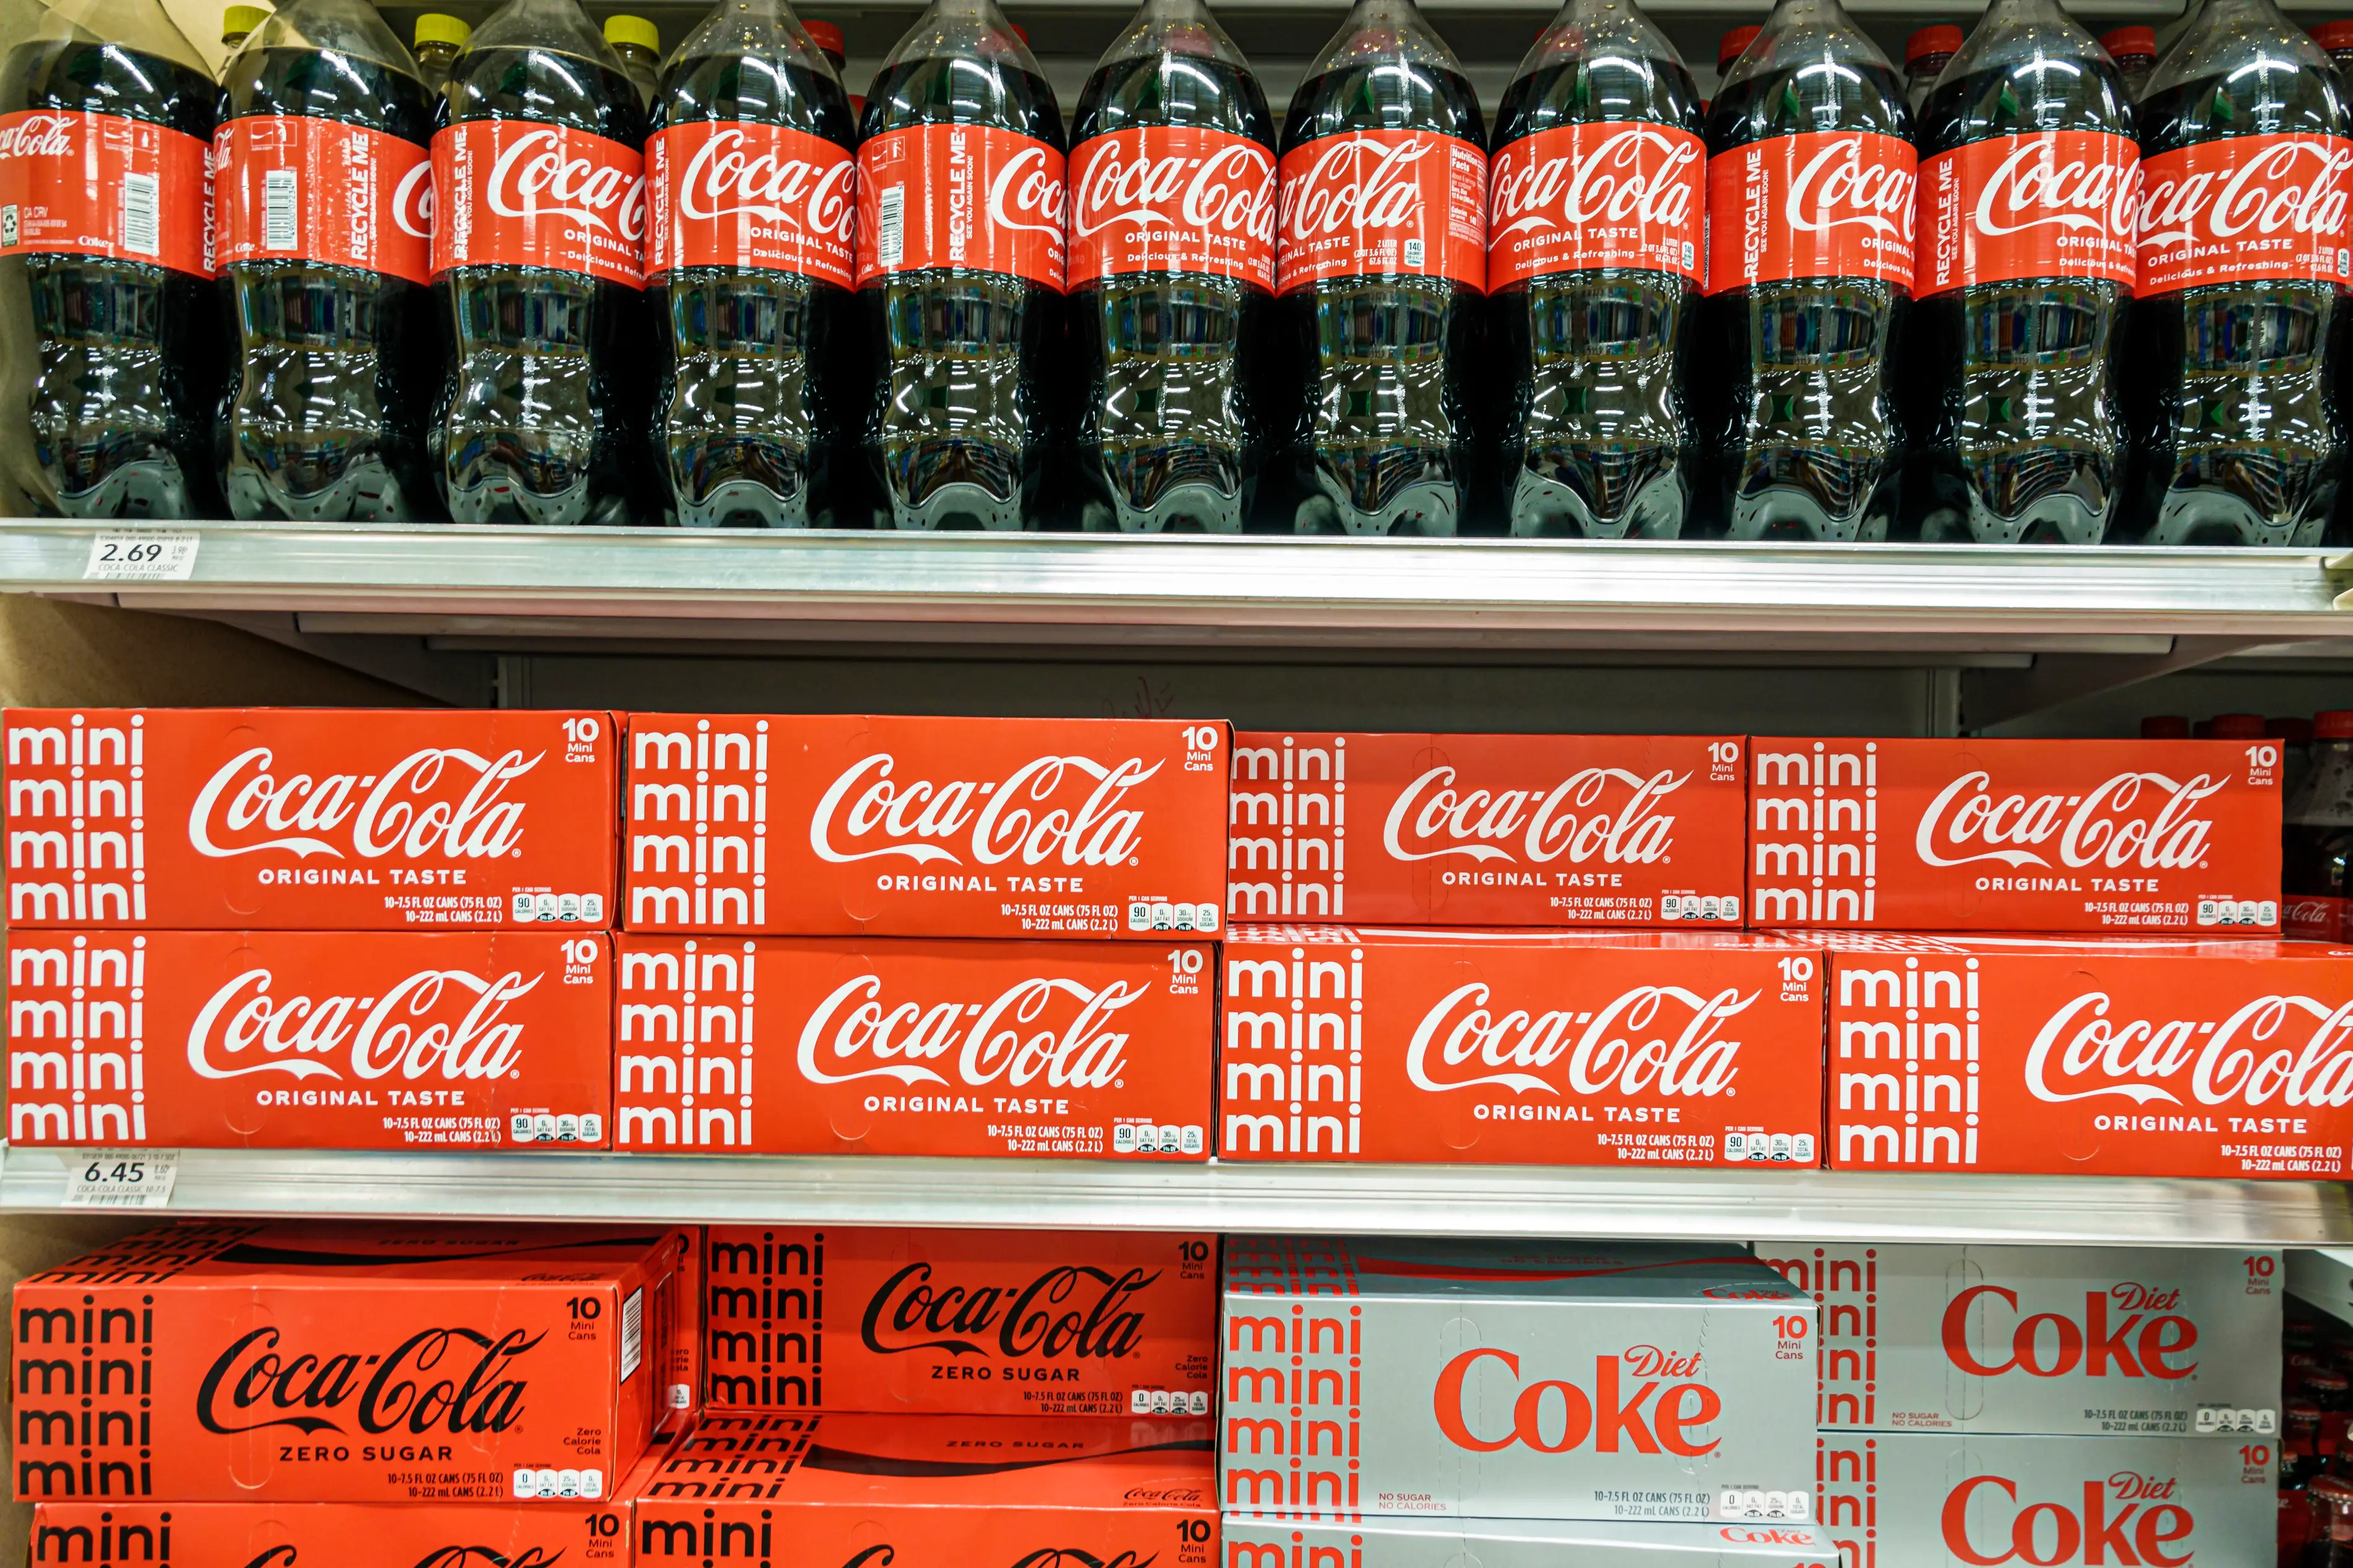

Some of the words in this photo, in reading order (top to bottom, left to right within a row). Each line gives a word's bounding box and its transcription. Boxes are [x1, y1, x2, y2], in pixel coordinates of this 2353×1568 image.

[0, 116, 78, 158] a-Cola
[352, 131, 369, 165] ME
[950, 131, 965, 166] ME
[204, 147, 215, 181] ME
[656, 137, 665, 169] ME
[1452, 147, 1477, 166] Nutrition
[1452, 158, 1470, 172] Facts
[1747, 149, 1761, 182] ME
[1939, 157, 1952, 191] ME
[487, 129, 645, 241] Coca-C
[681, 129, 856, 244] Coca-Co
[1076, 140, 1277, 246] Coca-Cola
[1278, 139, 1435, 241] a-Cola
[1488, 130, 1699, 251] Coca-Cola
[1786, 139, 1917, 243] Coca-
[1975, 139, 2140, 236] Coca-C
[2138, 141, 2353, 248] ca-Cola
[351, 168, 368, 261] RECYCLE
[655, 171, 664, 265] RECYCLE
[950, 168, 965, 261] RECYCLE
[203, 183, 215, 272] RECYCLE
[1744, 185, 1760, 278] RECYCLE
[1936, 193, 1952, 286] RECYCLE
[78, 236, 109, 247] Coke
[564, 228, 632, 257] ORIGINAL
[750, 227, 822, 249] ORIGINAL
[825, 241, 853, 264] TASTE
[1125, 231, 1200, 243] ORIGINAL
[1207, 233, 1246, 251] TASTE
[1308, 236, 1350, 251] TASTE
[1382, 240, 1397, 248] LITER
[1409, 243, 1421, 251] 140
[1514, 229, 1582, 253] ORIGINAL
[1588, 228, 1638, 239] TASTE
[1861, 237, 1910, 256] ORIGINAL
[2057, 236, 2122, 252] ORIGINAL
[568, 251, 615, 269] Delicious
[753, 248, 802, 262] Delicious
[806, 257, 812, 266] &
[815, 259, 852, 282] Refreshing
[1128, 254, 1179, 262] Delicious
[1181, 253, 1188, 261] &
[1191, 254, 1243, 270] Refreshing
[1516, 254, 1559, 271] Delicious
[1563, 253, 1569, 261] &
[1574, 249, 1635, 260] Refreshing
[2059, 258, 2107, 268] Delicious
[2147, 243, 2231, 267] ORIGINAL
[2237, 239, 2292, 252] TASTE
[1300, 259, 1347, 275] Refreshing
[1864, 259, 1900, 272] Delicious
[2150, 270, 2202, 285] Delicious
[2207, 266, 2214, 274] &
[2220, 261, 2289, 273] Refreshing
[100, 544, 162, 561] 2.69
[9, 714, 144, 765] mini
[563, 718, 599, 742] 10
[1183, 727, 1217, 750] 10
[635, 719, 768, 770] mini
[1186, 752, 1211, 761] Mini
[2246, 747, 2276, 766] 10
[1184, 762, 1213, 771] Cans
[189, 748, 546, 859] Coca-Cola
[635, 771, 767, 821] mini
[811, 753, 1166, 866] Coca-Cola
[1384, 766, 1694, 863] Coca-Cola
[1916, 771, 2230, 868] Coca-Cola
[633, 823, 766, 872] mini
[259, 869, 380, 884] ORIGINAL
[390, 870, 466, 884] TASTE
[877, 875, 996, 891] ORIGINAL
[1007, 877, 1082, 892] TASTE
[1442, 872, 1546, 885] ORIGINAL
[1556, 873, 1622, 886] TASTE
[1976, 878, 2081, 891] ORIGINAL
[2092, 879, 2158, 891] TASTE
[632, 875, 766, 924] mini
[1001, 904, 1027, 916] 10-7.5
[1029, 904, 1038, 916] FL
[1040, 904, 1050, 916] OZ
[1053, 904, 1074, 916] CANS
[1076, 904, 1090, 917] (75
[1092, 904, 1101, 916] FL
[1103, 904, 1118, 917] OZ)
[2282, 901, 2329, 922] a-Cola
[1134, 907, 1146, 917] 90
[1022, 919, 1050, 930] 10-222
[1051, 919, 1064, 930] mL
[1066, 919, 1088, 930] CANS
[1090, 919, 1108, 931] (2.2
[1109, 919, 1118, 931] L)
[561, 940, 598, 963] 10
[1168, 950, 1203, 973] 10
[1778, 957, 1813, 981] 10
[1840, 956, 1979, 1008] mini
[188, 969, 544, 1080] Coca-Cola
[798, 975, 1151, 1088] Coca-Cola
[1407, 983, 1762, 1096] Coca-Cola
[2025, 992, 2353, 1107] Coca-Cola
[864, 1096, 983, 1112] ORIGINAL
[994, 1098, 1068, 1114] TASTE
[1474, 1104, 1593, 1120] ORIGINAL
[1604, 1107, 1679, 1122] TASTE
[2095, 1115, 2217, 1132] ORIGINAL
[2229, 1118, 2306, 1133] TASTE
[85, 1162, 144, 1182] 6.45
[1178, 1241, 1209, 1262] 10
[2243, 1256, 2274, 1276] 10
[567, 1298, 600, 1319] 10
[2111, 1282, 2180, 1311] Diet
[19, 1295, 154, 1345] mini
[861, 1262, 1163, 1359] Coca-Cola
[1229, 1304, 1361, 1353] mini
[1773, 1315, 1807, 1338] 10
[1942, 1284, 2198, 1379] Coke
[1775, 1350, 1803, 1359] Cans
[1777, 1341, 1801, 1349] Mini
[932, 1366, 991, 1379] ZERO
[1003, 1368, 1079, 1380] SUGAR
[1624, 1345, 1702, 1378] Diet
[196, 1326, 549, 1436] Coca-Cola
[1433, 1347, 1721, 1457] Coke
[563, 1437, 601, 1446] Calorie
[576, 1427, 601, 1436] Zero
[281, 1447, 348, 1460] ZERO
[363, 1447, 451, 1460] SUGAR
[576, 1447, 601, 1455] Cola
[1123, 1488, 1203, 1502] Coca-Cola
[1398, 1493, 1432, 1501] SUGAR
[2108, 1471, 2177, 1500] Diet
[1379, 1502, 1394, 1510] NO
[1398, 1502, 1446, 1510] CALORIES
[1942, 1475, 2194, 1568] Coke
[1720, 1527, 1817, 1546] Coke
